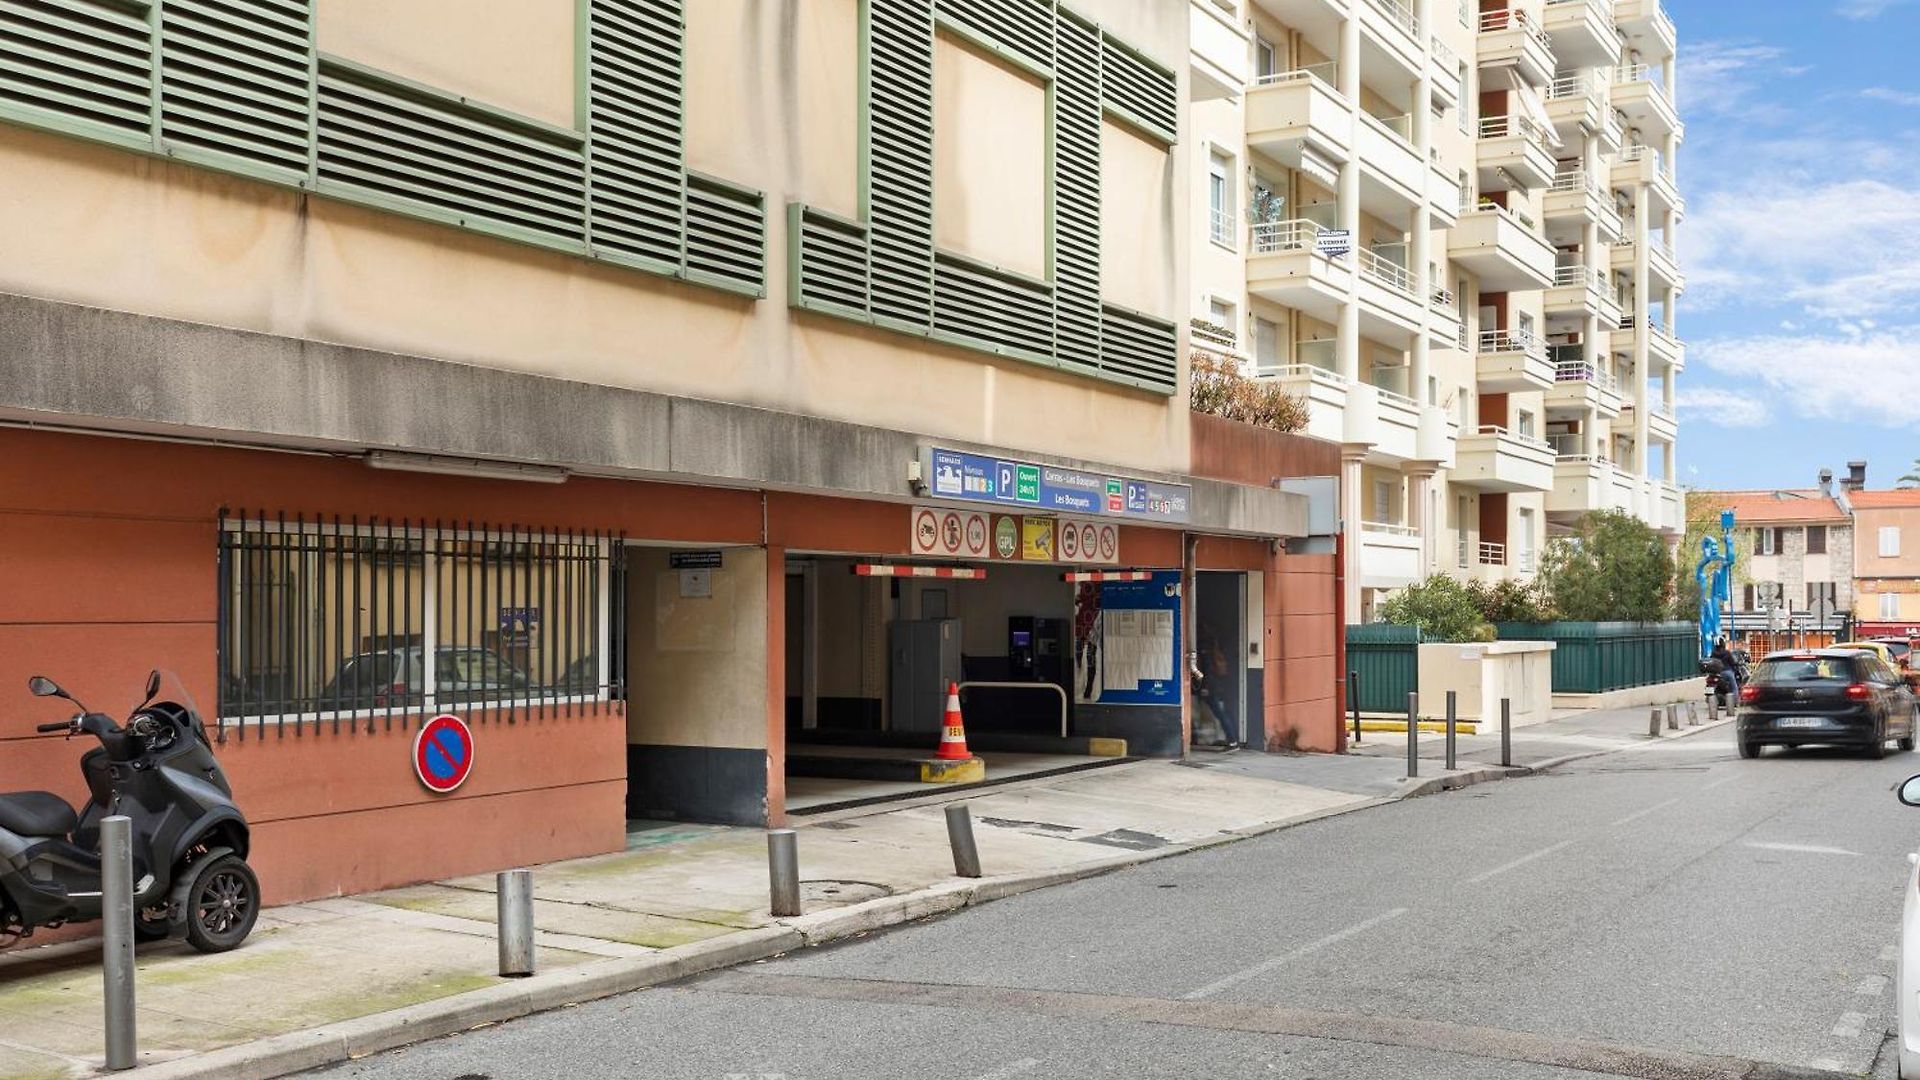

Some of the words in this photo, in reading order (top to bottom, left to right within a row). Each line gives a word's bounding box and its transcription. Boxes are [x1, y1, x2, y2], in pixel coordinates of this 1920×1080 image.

[1002, 469, 1011, 493] P
[1055, 493, 1064, 504] Les
[1128, 486, 1136, 509] P
